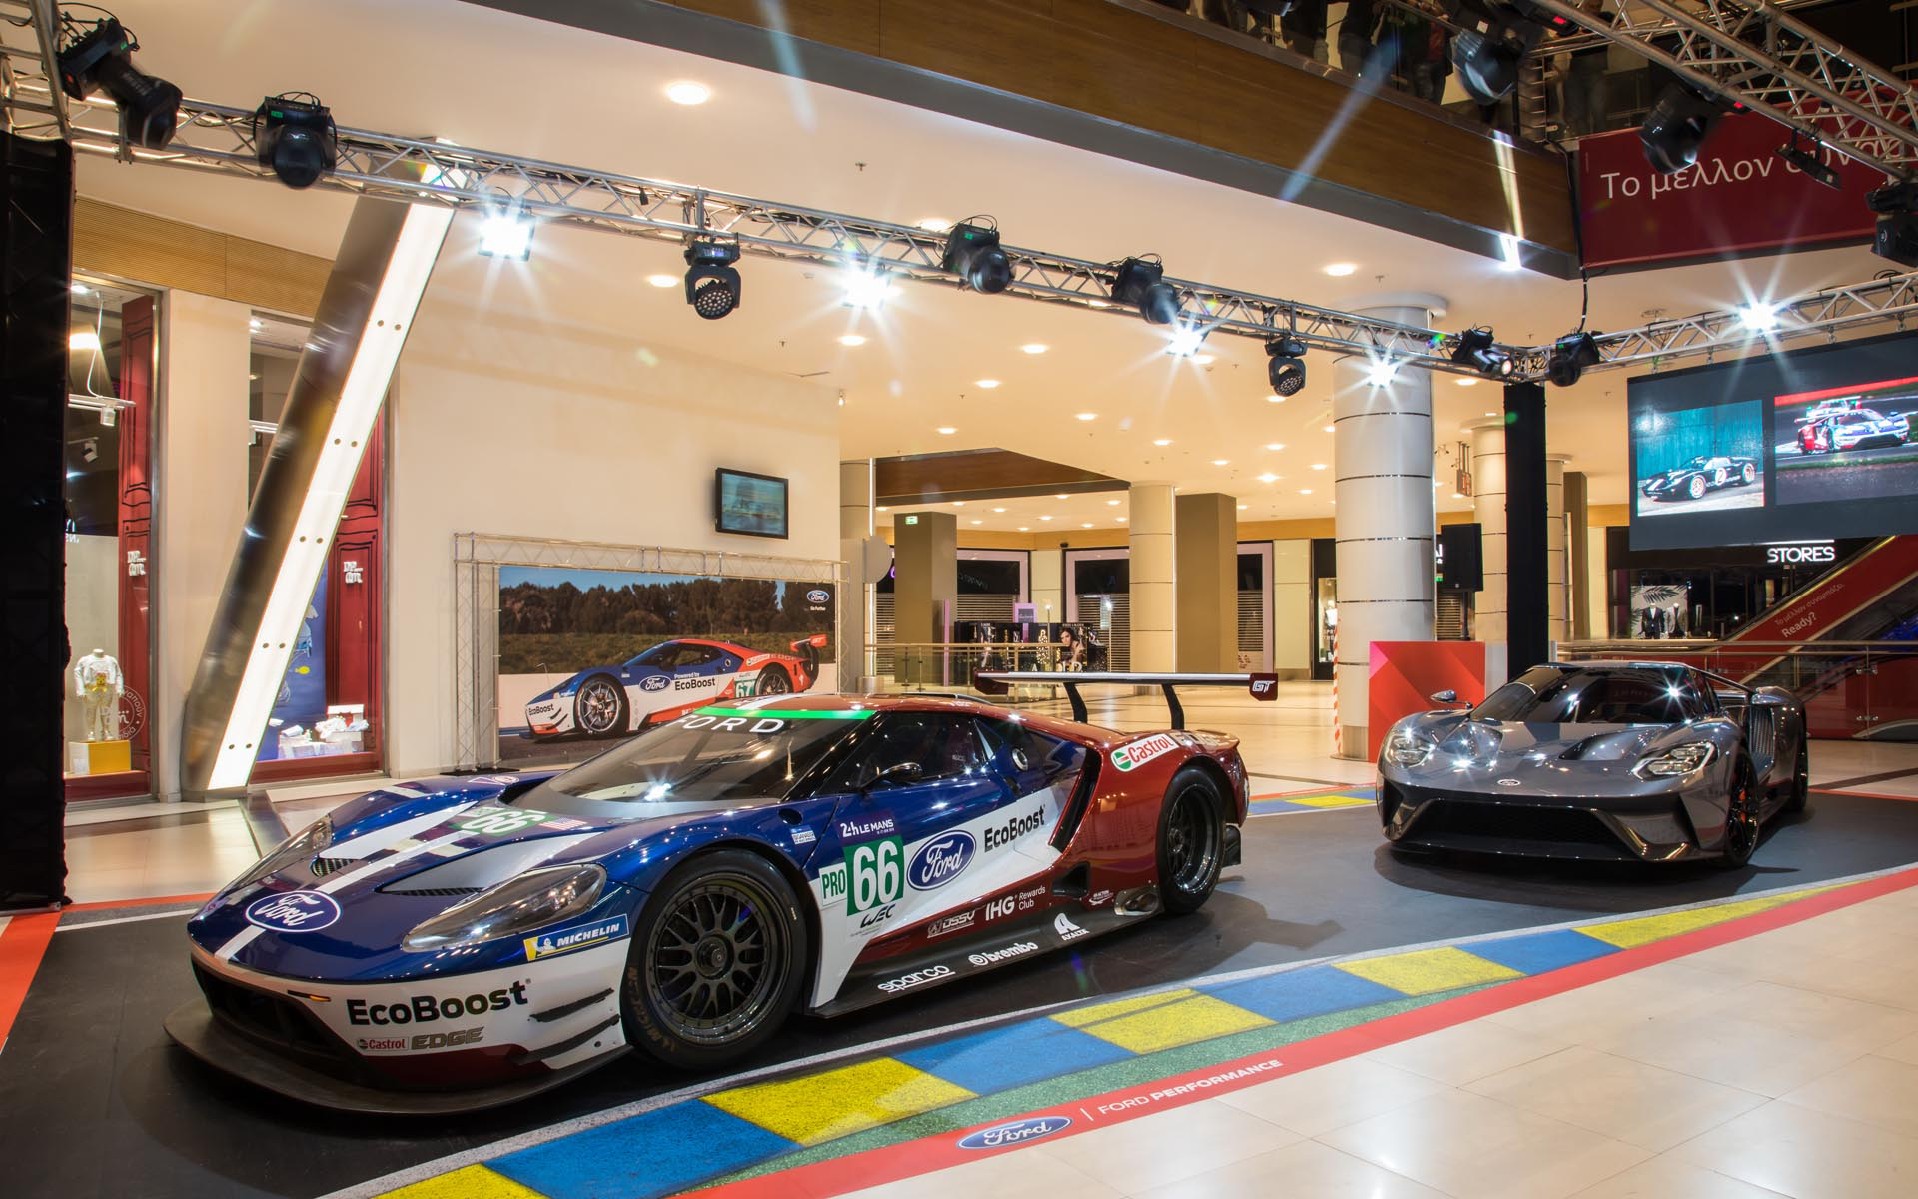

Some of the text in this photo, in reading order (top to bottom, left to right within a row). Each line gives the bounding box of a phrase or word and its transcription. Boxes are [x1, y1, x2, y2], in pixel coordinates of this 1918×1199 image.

[1600, 172, 1641, 199] Το
[1767, 546, 1836, 563] STORES
[1781, 611, 1817, 638] Ready?
[674, 677, 716, 691] EcoBoost
[736, 681, 755, 698] 67
[1251, 680, 1276, 693] GT
[528, 703, 554, 716] EcoBoost
[665, 714, 785, 733] FORD
[1127, 736, 1174, 763] Castrol
[462, 810, 546, 834] 66
[859, 824, 870, 834] LE
[871, 819, 894, 832] MANS
[984, 806, 1045, 853] EcoBoost
[821, 869, 846, 899] PRO
[853, 840, 900, 911] 66
[1018, 886, 1046, 900] Rewards
[1018, 899, 1035, 910] Club
[860, 903, 896, 928] WEC
[985, 896, 1015, 921] IHG
[557, 922, 620, 946] MICHELIN
[1061, 928, 1090, 941] AXALTA
[985, 942, 1039, 963] brembo
[877, 965, 950, 991] sparco
[346, 980, 529, 1026] EcoBoost
[368, 1026, 484, 1050] Castrol EDGE
[1098, 1059, 1283, 1115] FORD PERFORMANCE
